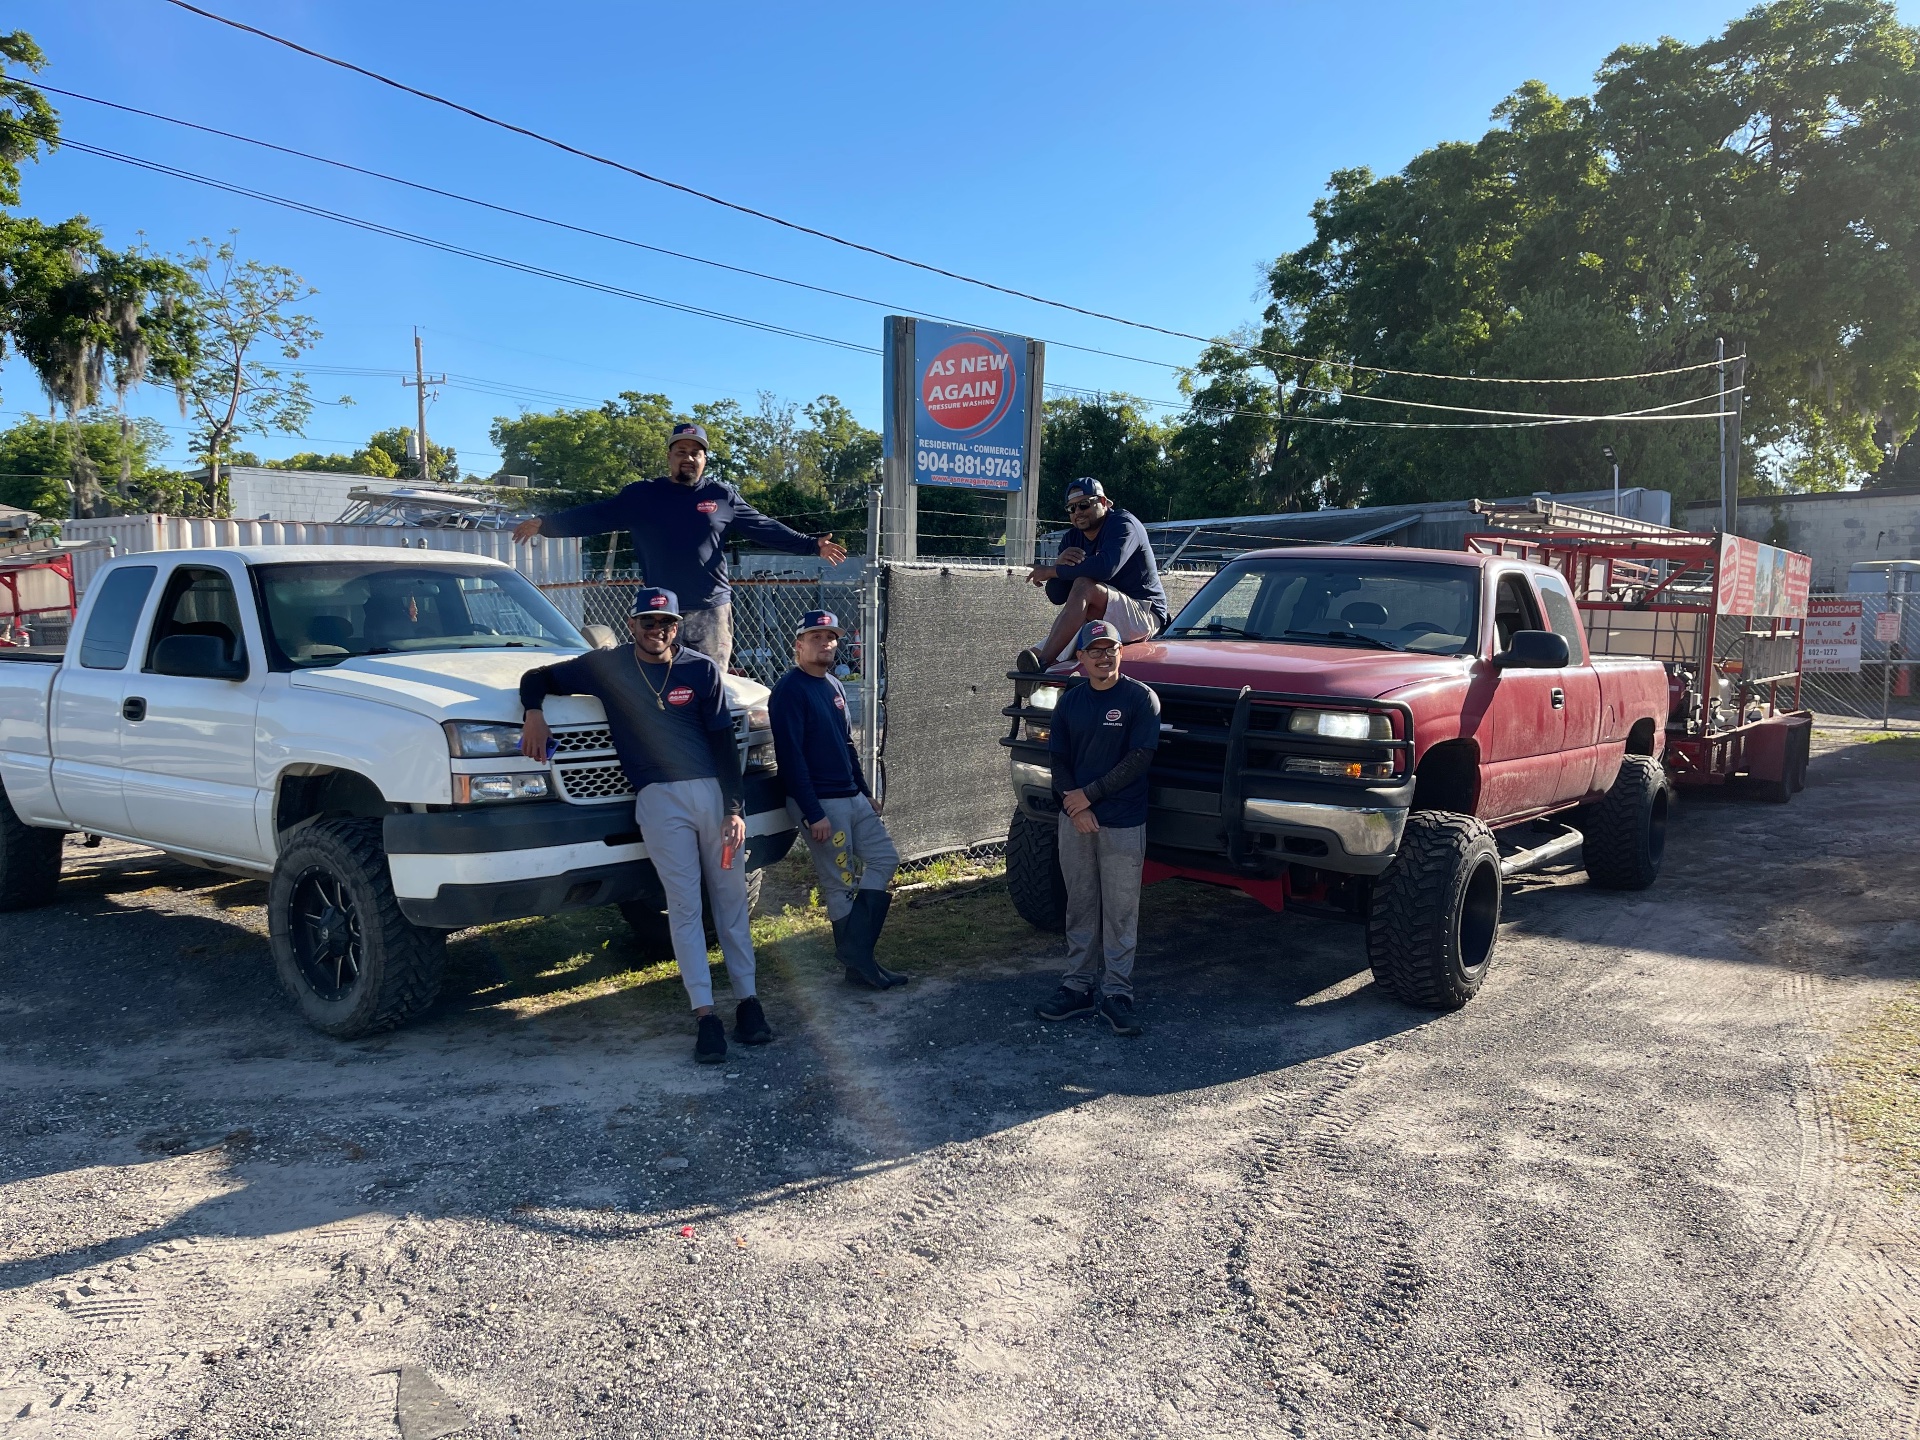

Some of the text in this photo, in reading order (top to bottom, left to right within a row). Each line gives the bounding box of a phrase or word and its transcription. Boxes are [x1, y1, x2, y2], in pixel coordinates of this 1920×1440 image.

[929, 353, 1008, 377] AS NEW
[928, 381, 996, 401] AGAIN
[928, 399, 995, 411] PRESSURE WASHING
[919, 438, 1020, 457] RESIDENTIAL COMMERCIAL
[917, 450, 1021, 479] 904-881-9743
[1812, 605, 1861, 614] LANDSCAPE
